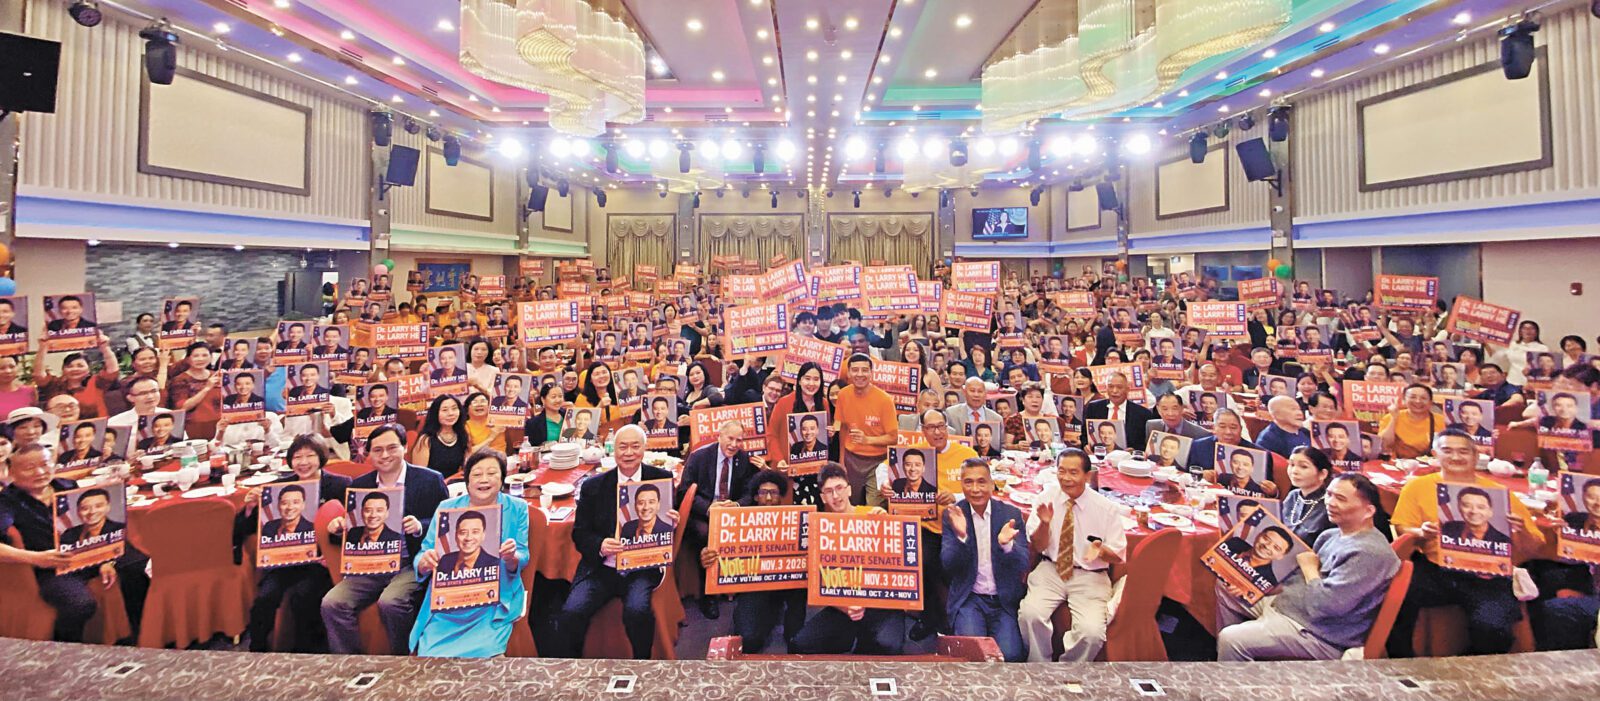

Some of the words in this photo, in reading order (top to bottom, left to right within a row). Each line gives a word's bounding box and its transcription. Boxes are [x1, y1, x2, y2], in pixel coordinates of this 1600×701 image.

[536, 303, 558, 311] LARRY
[560, 302, 568, 310] HE
[742, 307, 764, 317] LARRY
[766, 305, 776, 313] HE
[536, 312, 558, 320] LARRY
[742, 317, 764, 327] LARRY
[766, 316, 776, 324] HE
[789, 336, 797, 345] Dr.
[800, 339, 823, 350] LARRY
[824, 345, 834, 353] HE
[798, 347, 821, 360] LARRY
[822, 354, 832, 362] HE
[874, 364, 897, 373] LARRY
[899, 366, 909, 374] HE
[873, 373, 896, 383] LARRY
[898, 376, 909, 384] HE
[1352, 384, 1364, 392] Dr.
[1367, 384, 1399, 394] LARRY
[1352, 393, 1365, 402] Dr.
[1368, 394, 1398, 404] LARRY
[697, 414, 709, 423] Dr.
[711, 409, 739, 420] LARRY
[740, 407, 752, 417] HE
[699, 424, 710, 434] Dr.
[742, 418, 753, 428] HE
[749, 440, 764, 449] 2026
[898, 434, 909, 445] Dr.
[721, 513, 736, 526] Dr.
[741, 512, 779, 526] LARRY
[782, 511, 798, 524] HE
[820, 518, 836, 534] Dr.
[840, 519, 880, 535] LARRY
[884, 521, 900, 536] HE
[275, 532, 303, 542] LARRY
[304, 530, 315, 539] HE
[633, 533, 658, 544] LARRY
[660, 532, 670, 540] HE
[720, 529, 736, 543] Dr.
[740, 528, 778, 542] LARRY
[781, 527, 796, 540] HE
[60, 544, 74, 555] Dr.
[76, 533, 108, 548] LARRY
[110, 529, 123, 538] HE
[345, 542, 356, 550] Dr.
[357, 541, 385, 550] LARRY
[387, 540, 400, 548] HE
[820, 536, 836, 551] Dr.
[840, 536, 880, 552] LARRY
[884, 538, 901, 553] HE
[1442, 535, 1456, 545] Dr.
[1458, 537, 1492, 549] LARRY
[1494, 542, 1508, 551] HE
[720, 546, 736, 554] FOR
[766, 544, 796, 552] SENATE
[786, 558, 806, 570] 2026
[820, 554, 836, 563] FOR
[840, 555, 865, 564] STATE
[868, 556, 901, 566] SENATE
[1219, 543, 1232, 555] Dr.
[1231, 553, 1259, 579] LARRY
[1257, 576, 1272, 589] HE
[436, 572, 449, 581] Dr.
[451, 568, 482, 580] LARRY
[484, 566, 496, 576] HE
[865, 573, 888, 586] NOV.3
[892, 575, 914, 587] 2026
